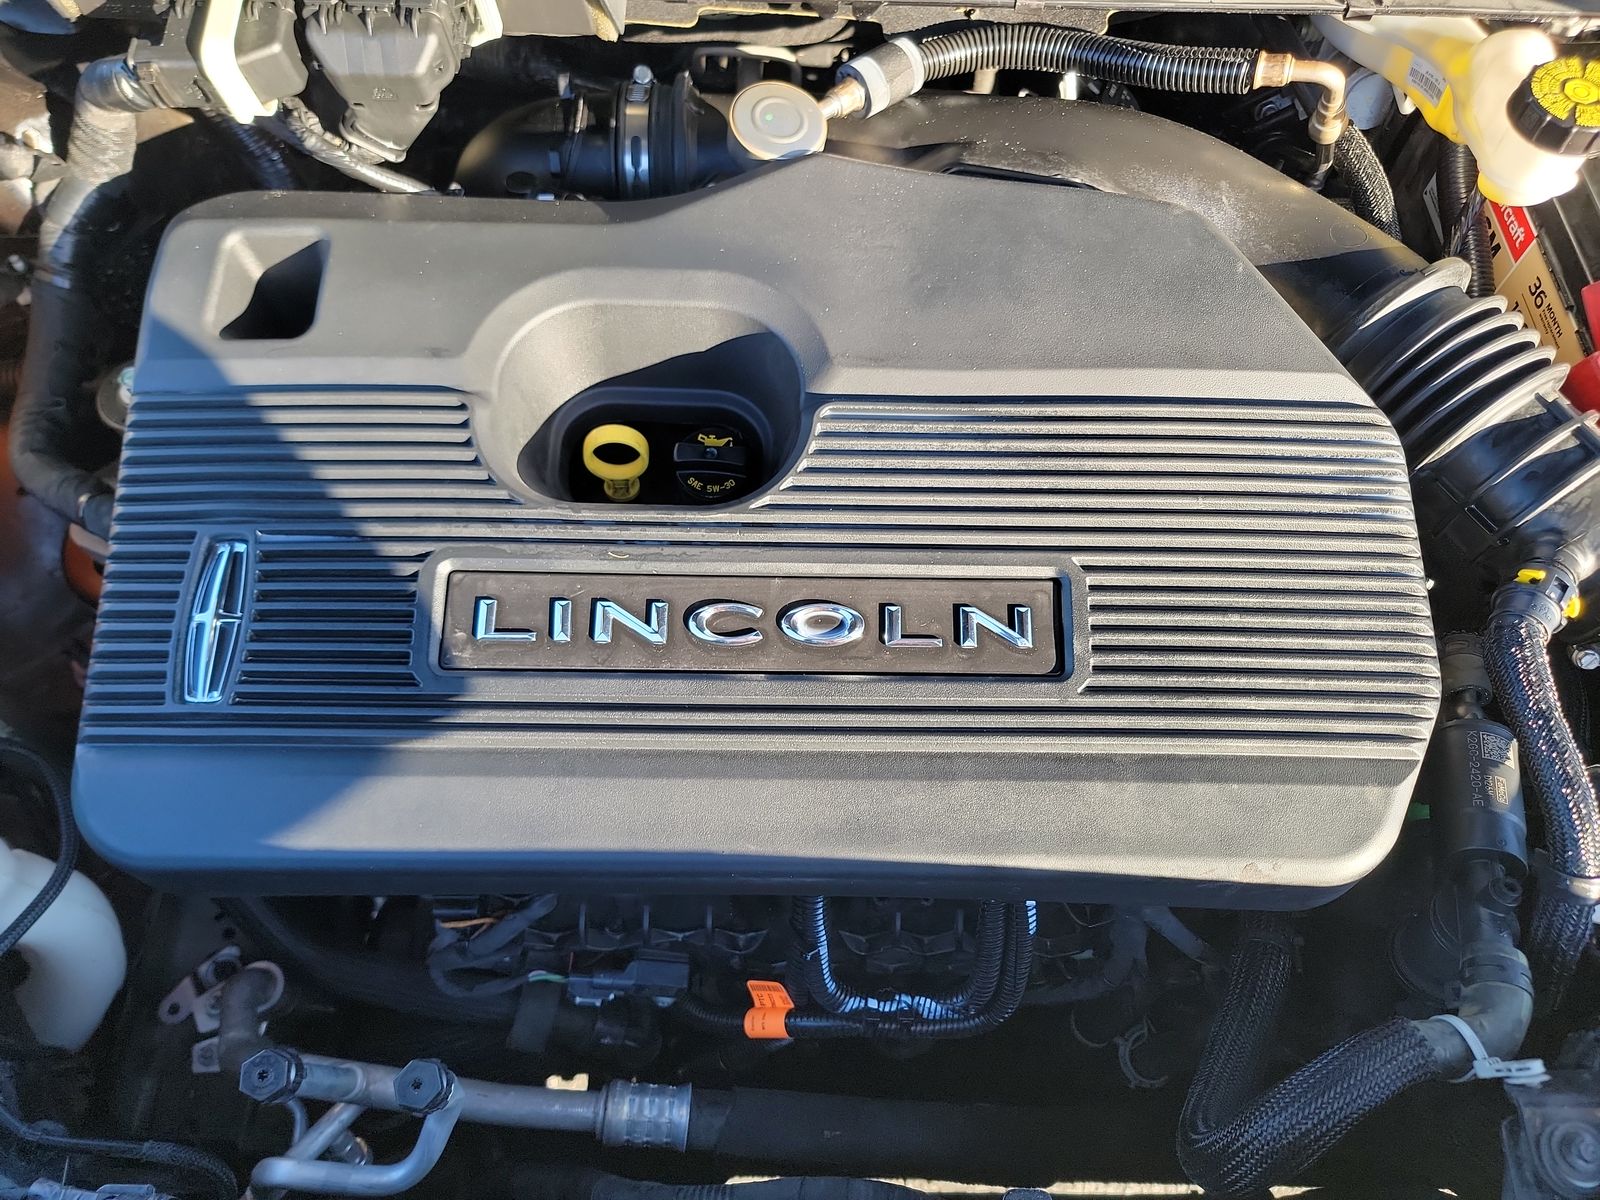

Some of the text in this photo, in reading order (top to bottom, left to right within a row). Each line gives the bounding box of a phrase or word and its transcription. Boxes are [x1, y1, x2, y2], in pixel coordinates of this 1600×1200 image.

[1528, 276, 1563, 338] 36 MONTH
[687, 477, 736, 493] SAE 5W-30
[473, 595, 1034, 650] LINCOLN
